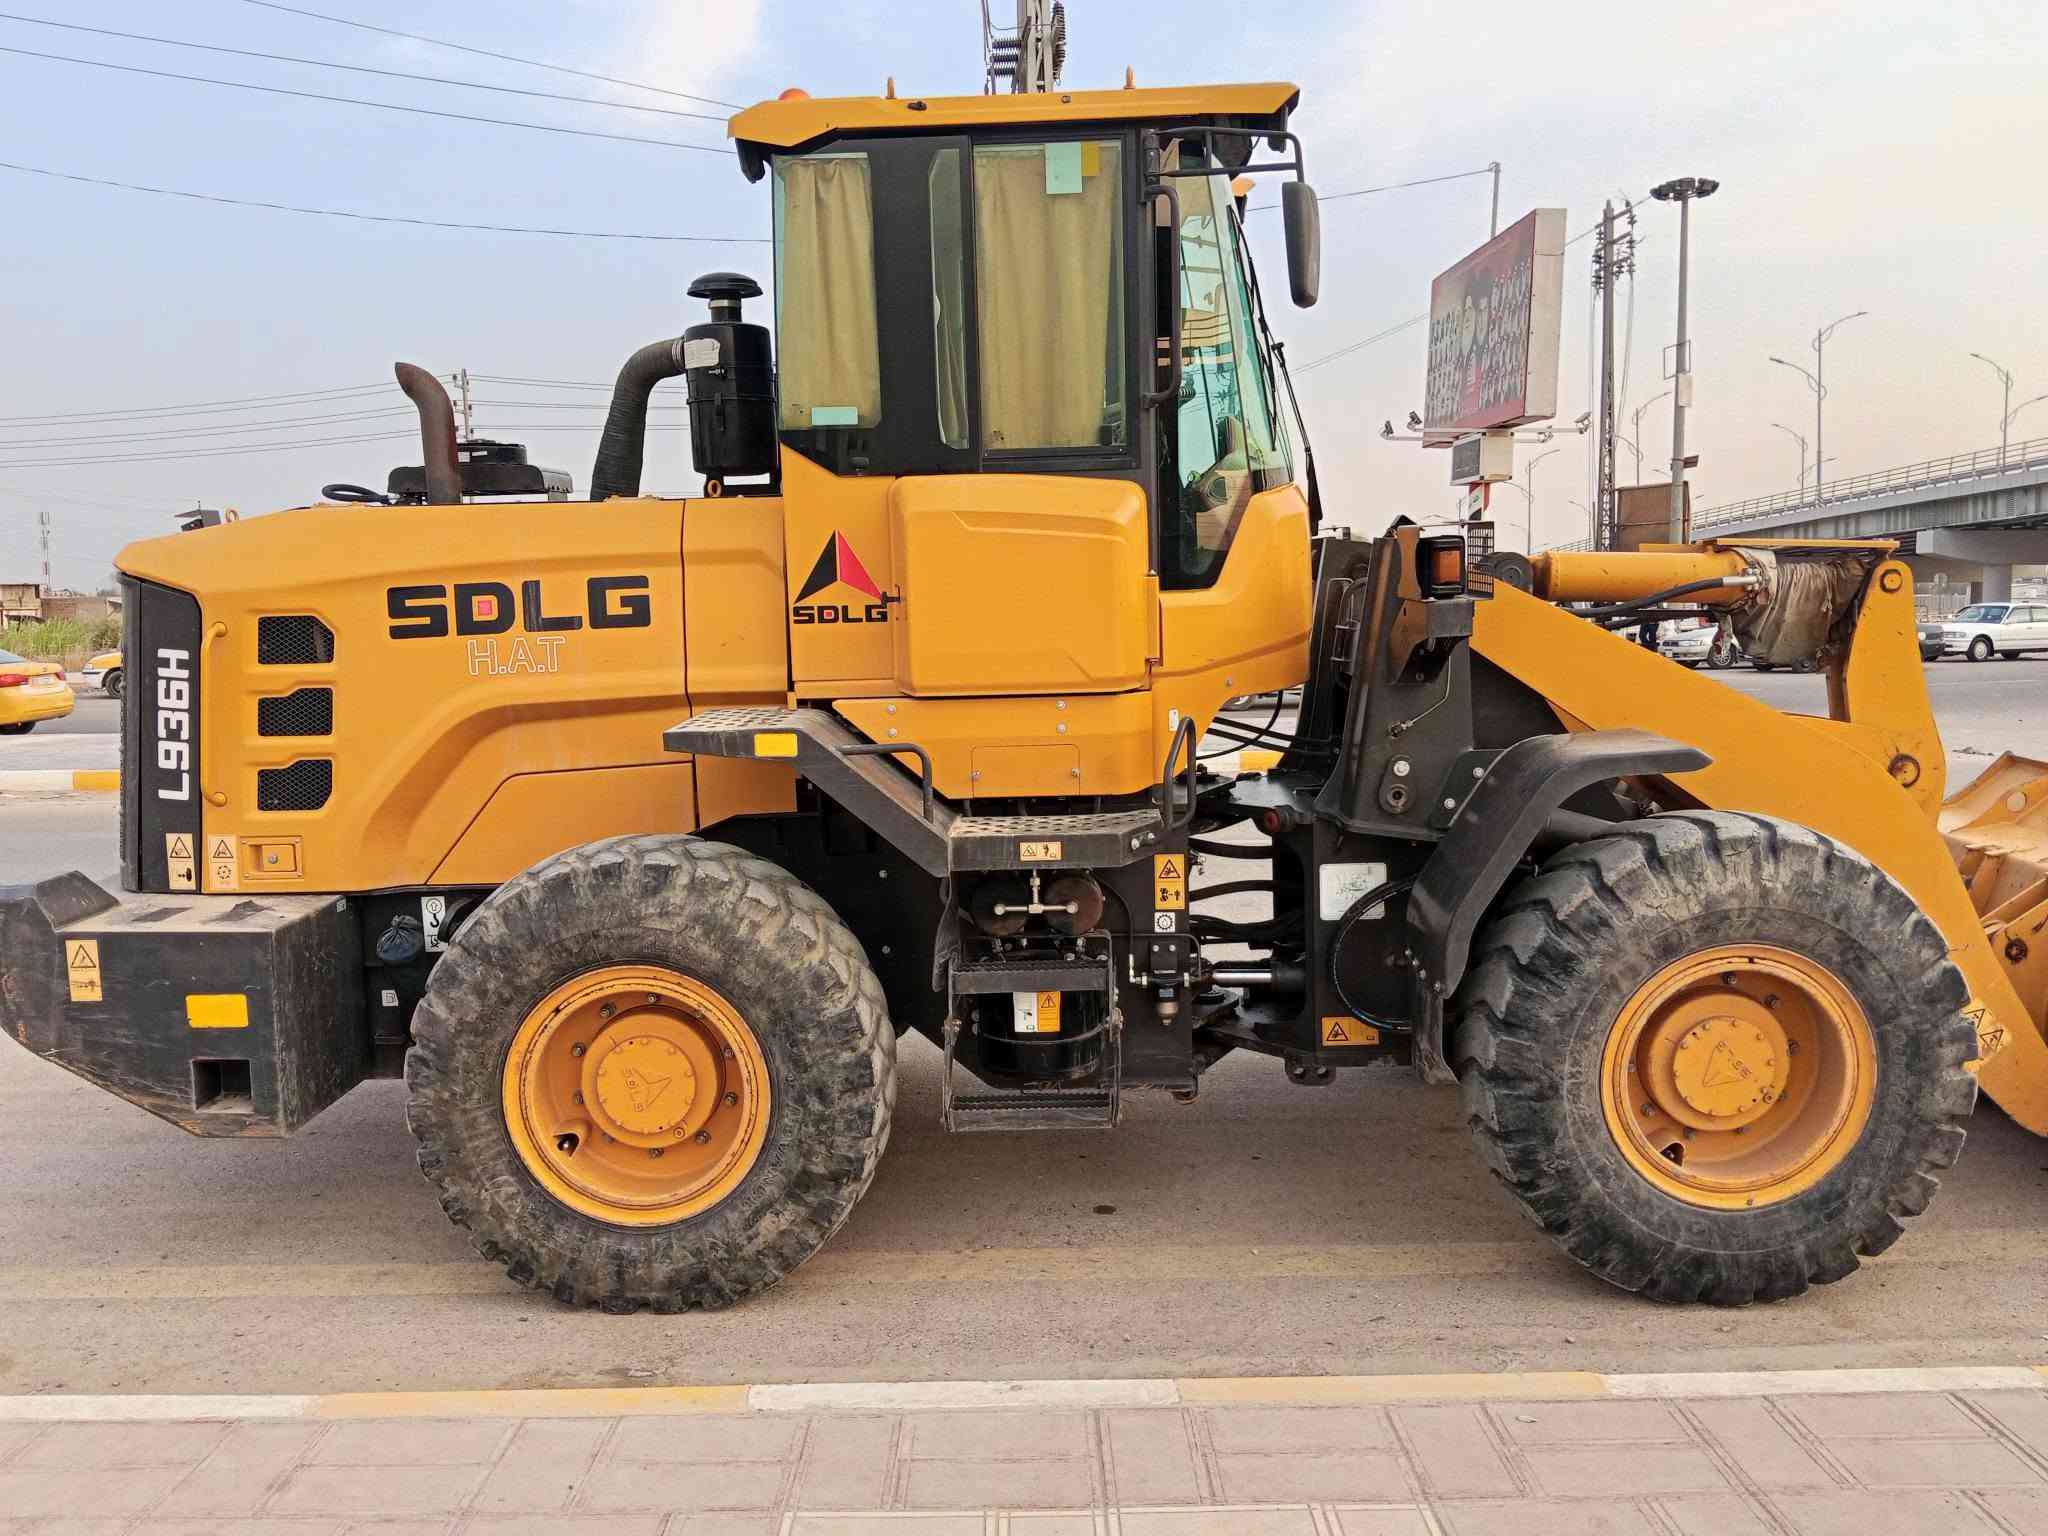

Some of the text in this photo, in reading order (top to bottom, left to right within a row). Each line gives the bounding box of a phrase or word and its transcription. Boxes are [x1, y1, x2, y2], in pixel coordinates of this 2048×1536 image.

[387, 575, 652, 639] SDLG
[793, 604, 888, 624] SDLG
[467, 635, 566, 675] H.A.T
[157, 648, 190, 801] L936H
